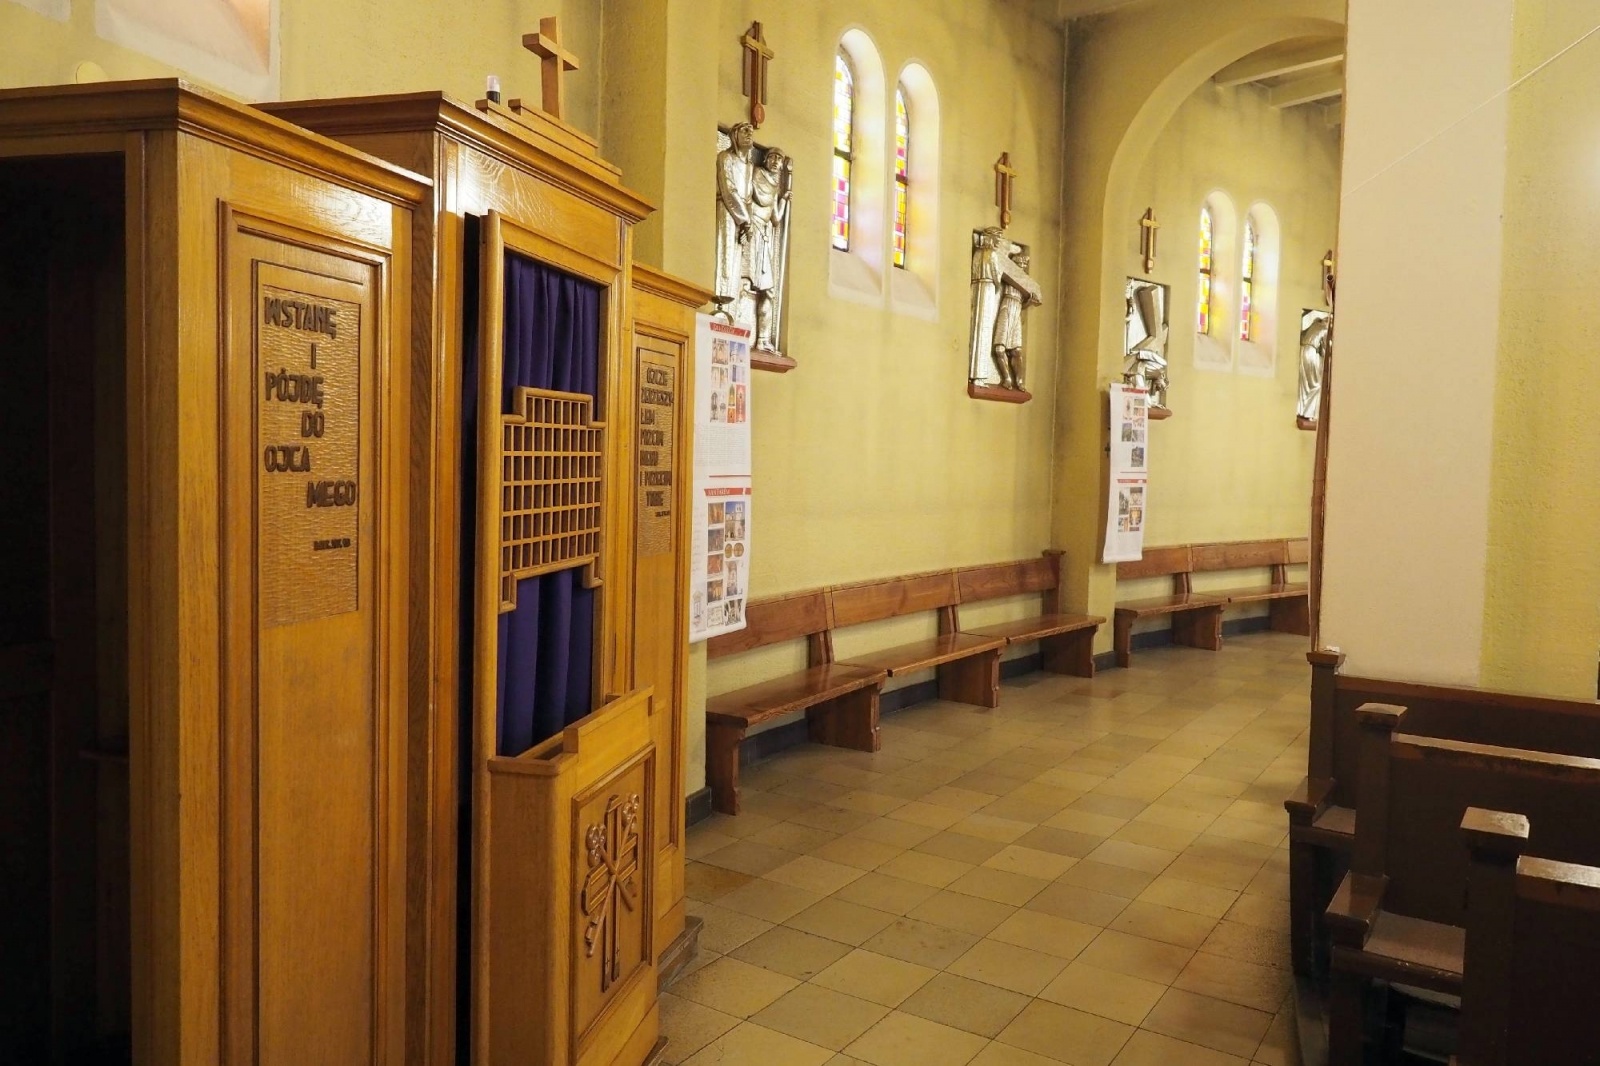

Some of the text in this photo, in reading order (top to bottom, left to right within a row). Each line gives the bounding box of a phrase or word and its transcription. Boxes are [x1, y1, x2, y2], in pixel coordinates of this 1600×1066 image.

[263, 296, 337, 339] WSTANĘ
[310, 342, 317, 369] I
[264, 368, 324, 410] PÓJDĘ
[300, 410, 325, 438] DO
[264, 445, 311, 473] OJCA
[306, 480, 357, 508] MEGO
